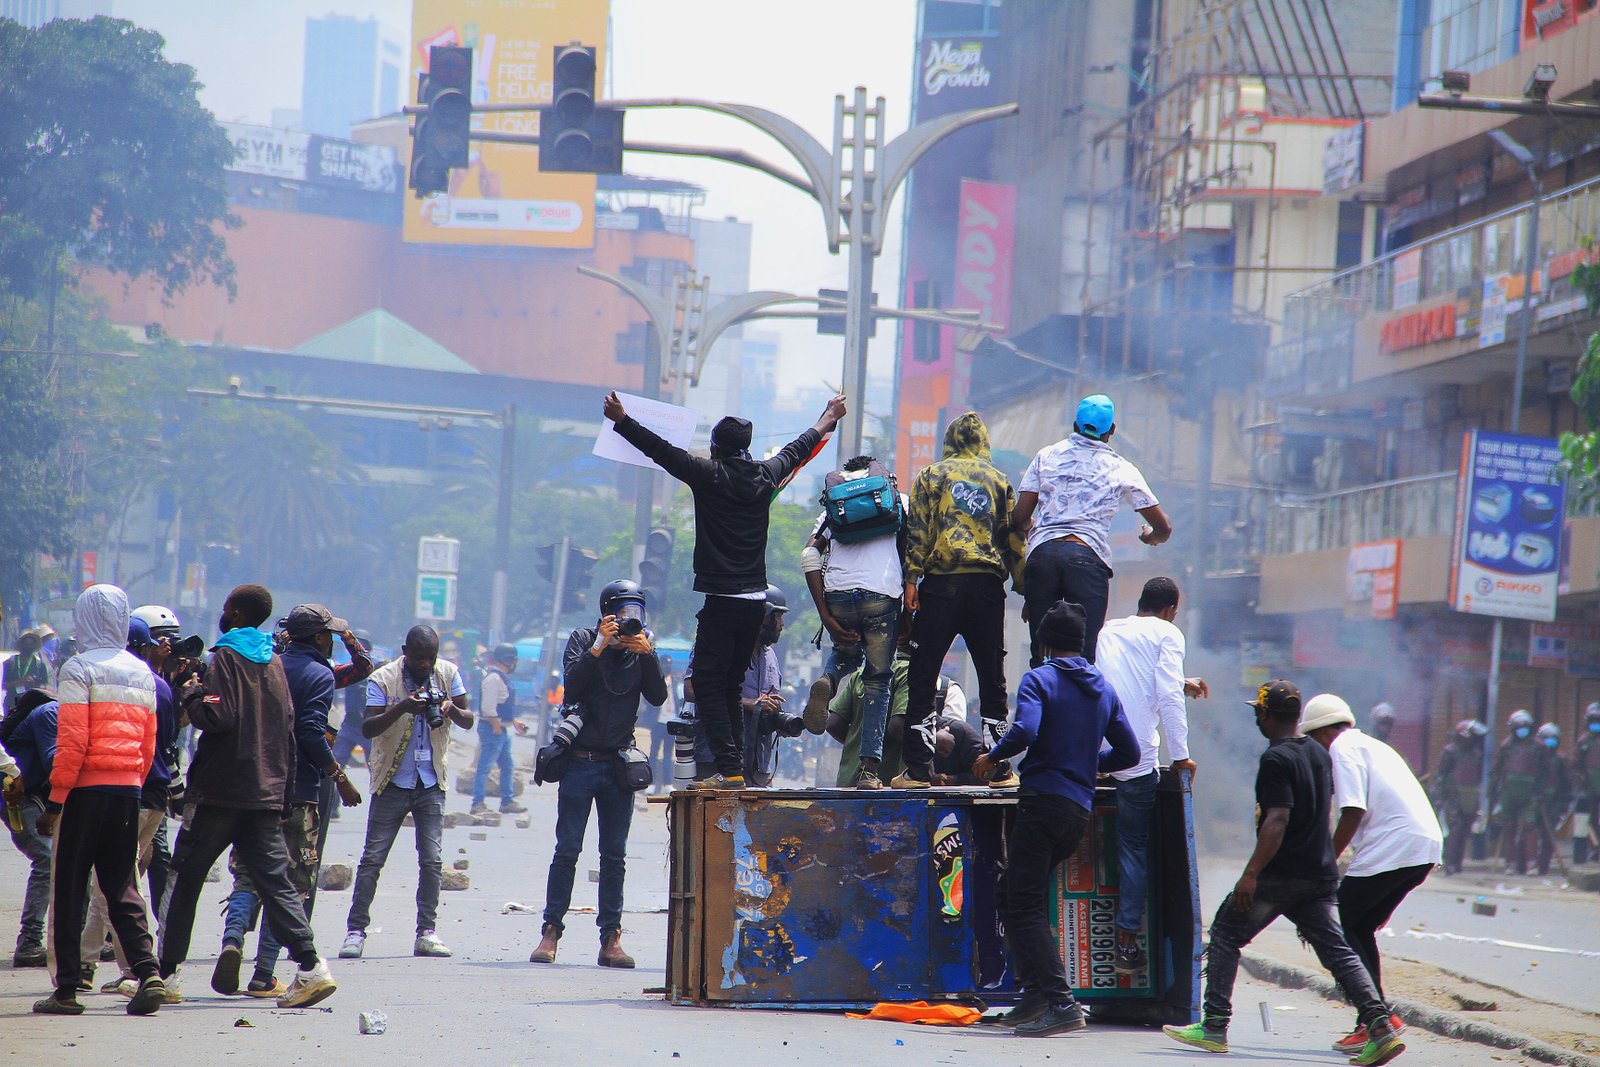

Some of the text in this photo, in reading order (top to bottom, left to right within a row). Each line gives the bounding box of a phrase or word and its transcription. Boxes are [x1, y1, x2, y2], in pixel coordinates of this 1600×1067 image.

[925, 40, 981, 70] Mega
[498, 63, 537, 81] FREE
[924, 65, 991, 96] Growth
[497, 81, 553, 99] DELIVE
[960, 198, 998, 326] ADY
[1495, 579, 1544, 594] RIKKO
[1069, 852, 1079, 886] AILABLE
[1057, 931, 1066, 964] ORIGIN
[1078, 902, 1089, 987] AGENT NAME
[1090, 899, 1116, 988] 2039603
